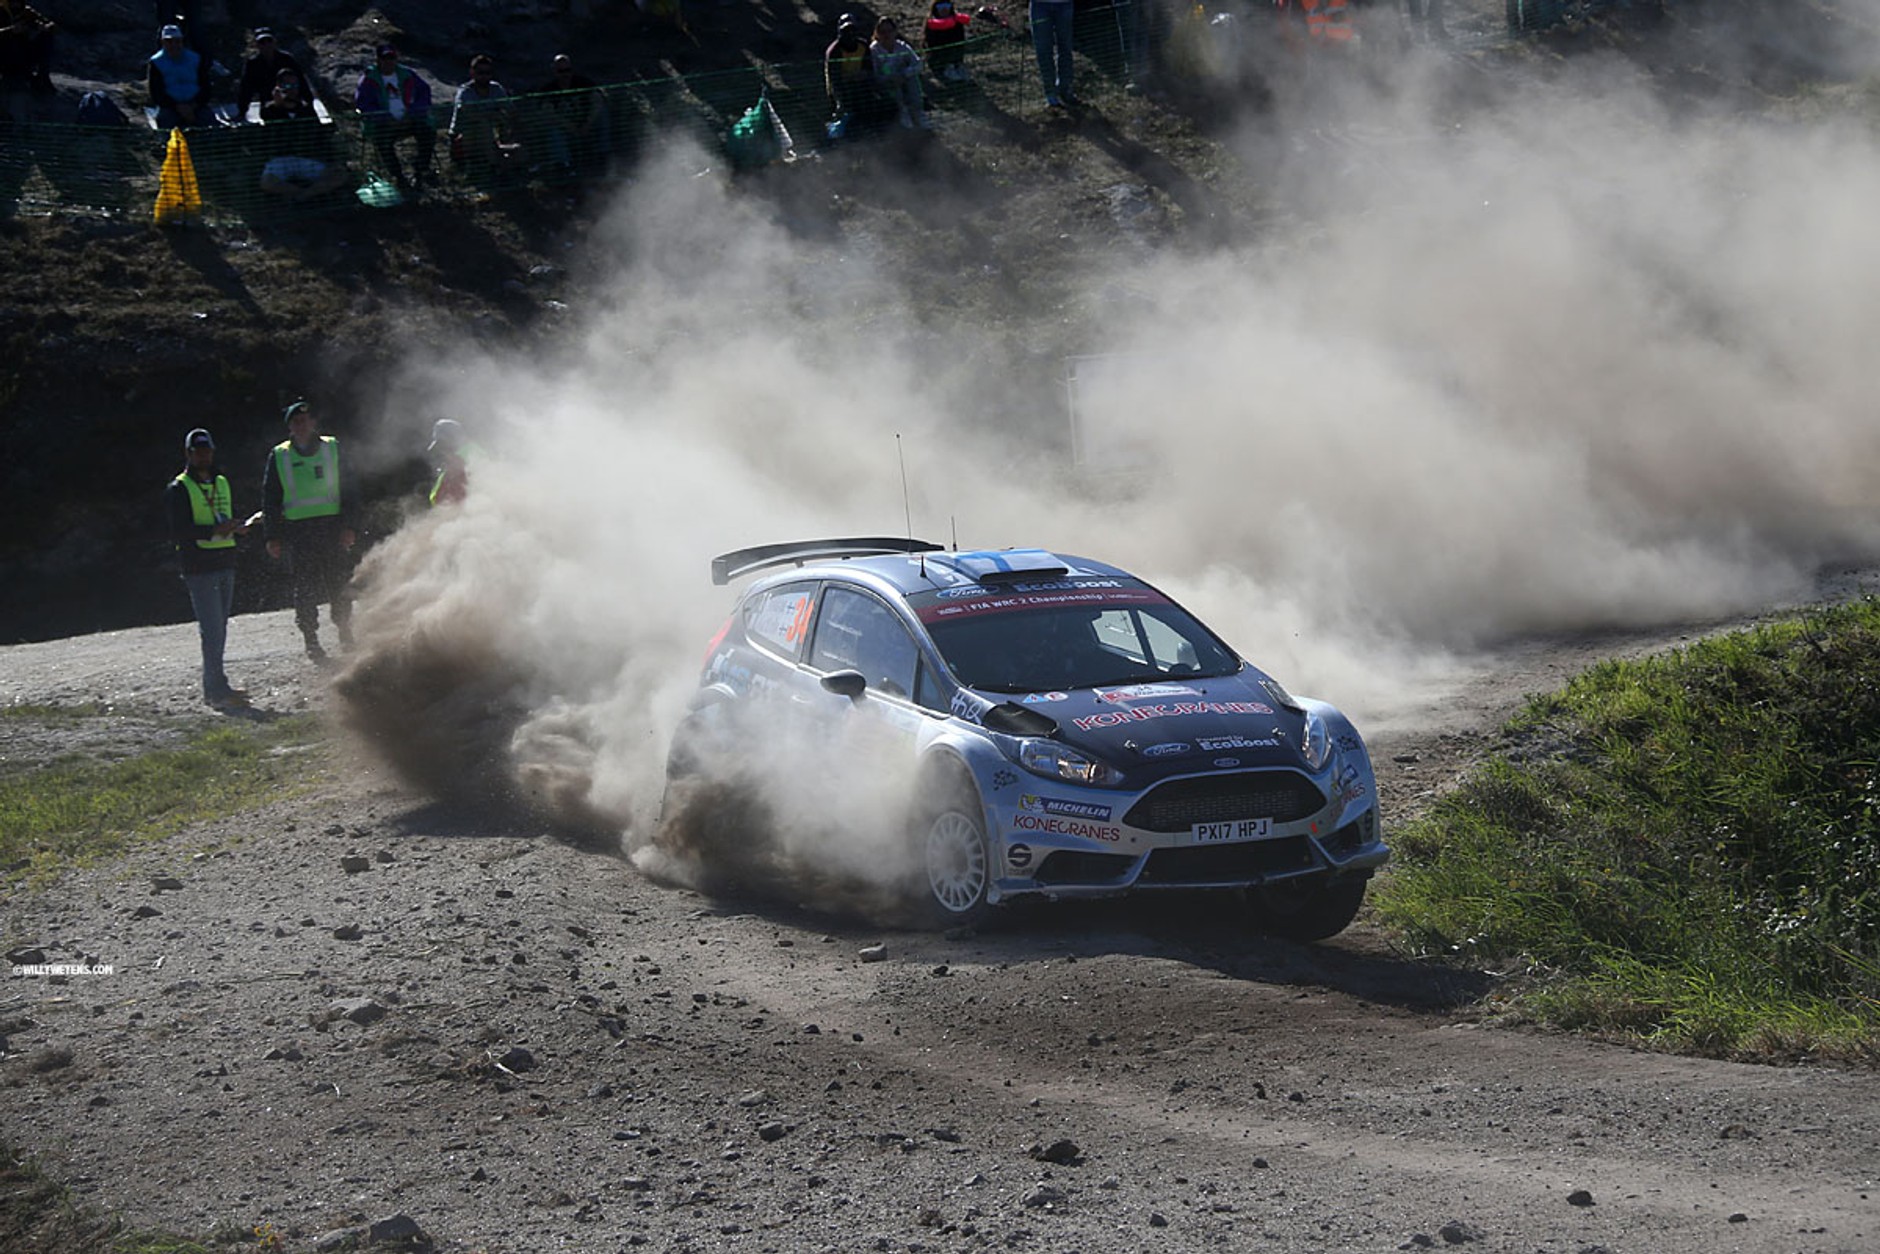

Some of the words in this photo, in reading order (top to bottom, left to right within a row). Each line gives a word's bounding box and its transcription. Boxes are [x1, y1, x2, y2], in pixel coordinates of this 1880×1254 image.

[970, 602, 990, 610] FIA
[992, 598, 1017, 608] WRC
[1029, 593, 1103, 604] Championship
[786, 597, 815, 643] 34
[1073, 702, 1274, 731] KONECRANES
[1200, 738, 1280, 751] EcoBoost
[1048, 802, 1110, 817] MICHELIN
[1013, 815, 1120, 841] KONECRANES
[1198, 824, 1232, 841] PX17
[1238, 820, 1268, 837] HPJ
